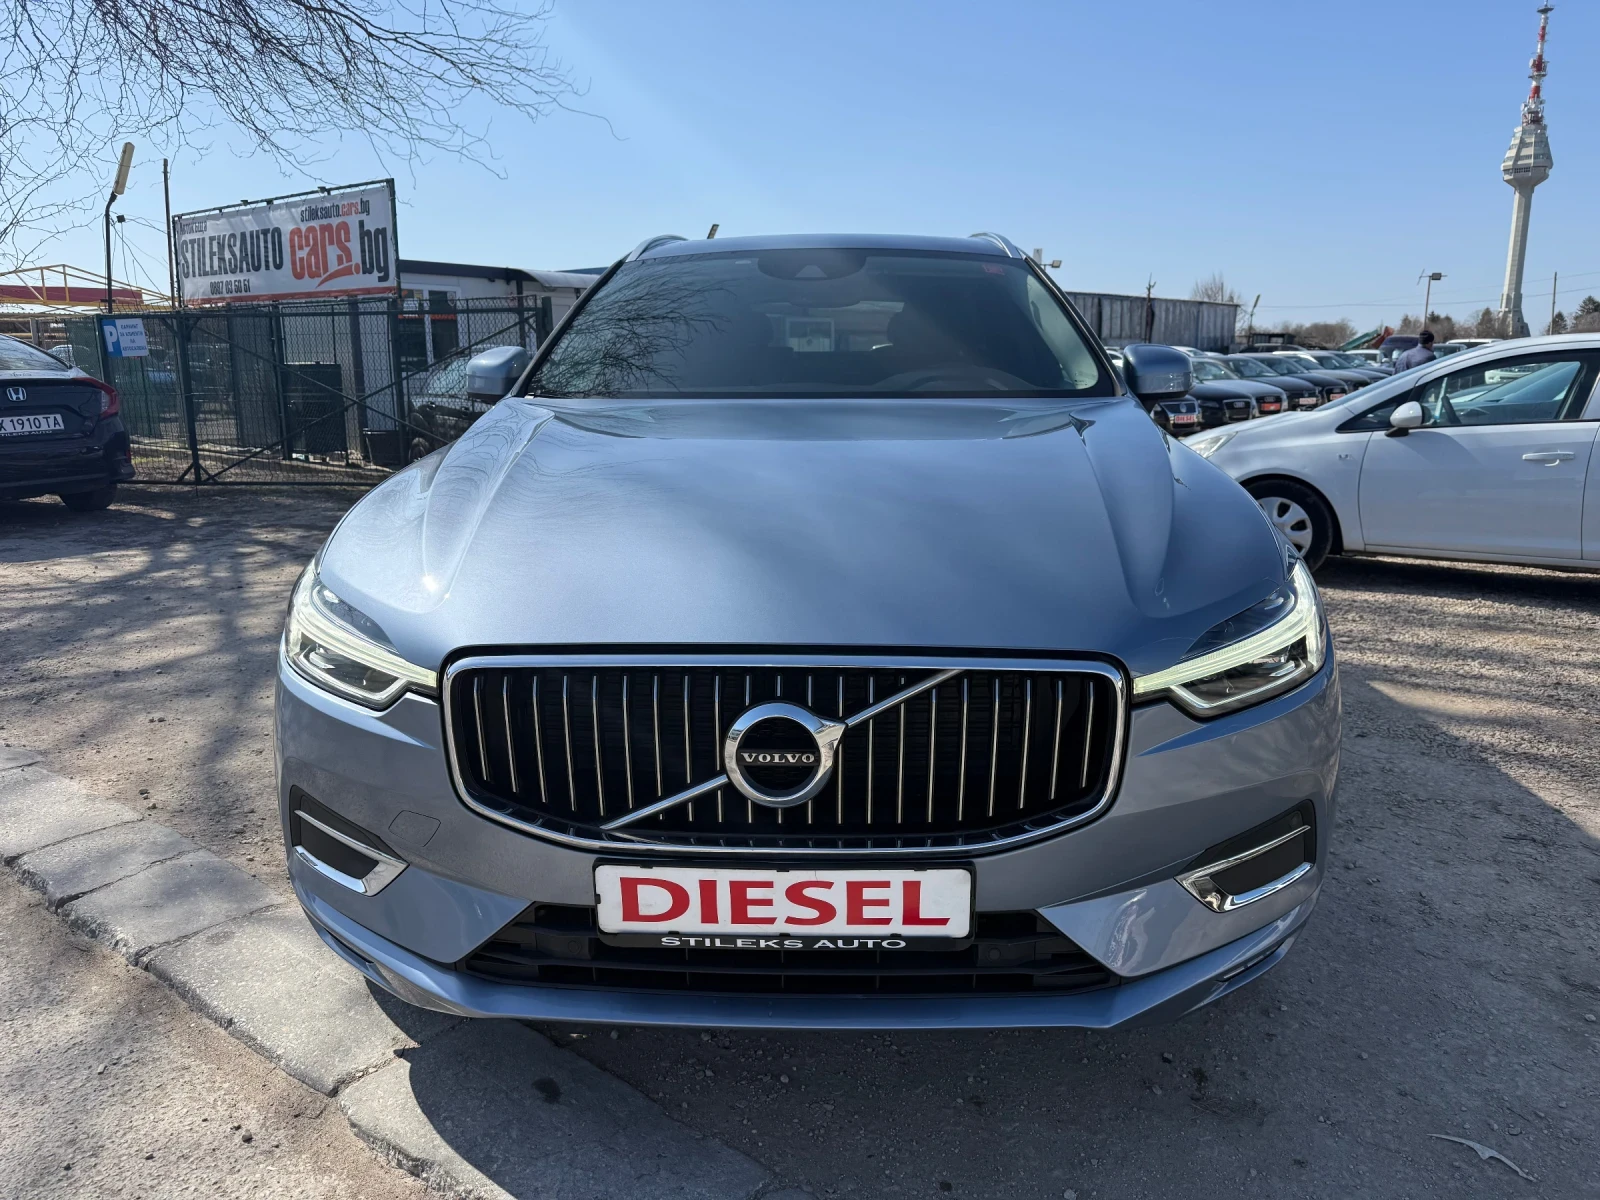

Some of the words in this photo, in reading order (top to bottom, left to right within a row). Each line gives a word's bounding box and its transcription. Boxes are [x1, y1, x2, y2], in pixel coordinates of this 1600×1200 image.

[300, 198, 370, 222] stileksauto.cars.bg
[180, 226, 284, 279] STILEKSAUTO
[289, 219, 390, 283] cars.bg
[9, 417, 41, 431] 1910
[42, 415, 61, 429] TA
[740, 752, 815, 763] VOLVO
[619, 876, 951, 926] DIESEL
[661, 936, 803, 949] STILEKS
[813, 939, 907, 949] AUTO
